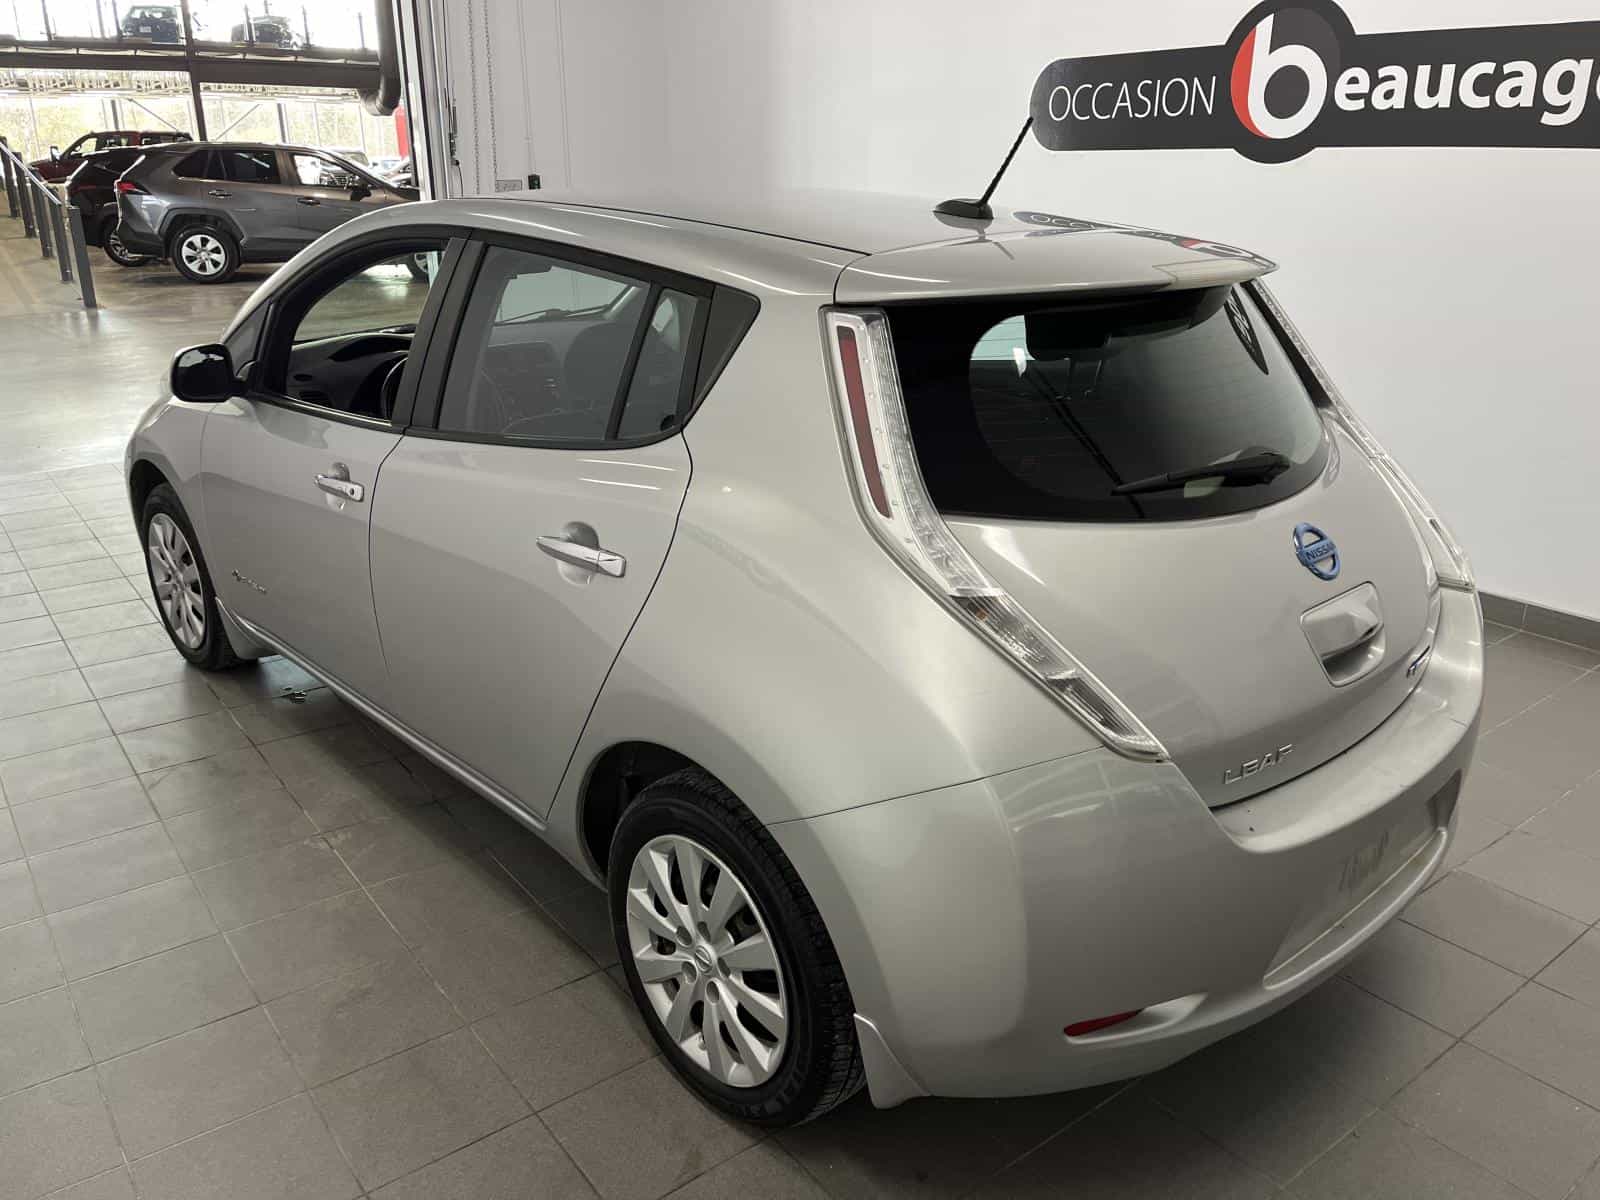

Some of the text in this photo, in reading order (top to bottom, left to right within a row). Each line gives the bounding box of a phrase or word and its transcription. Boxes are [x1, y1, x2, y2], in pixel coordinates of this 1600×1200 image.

[1048, 12, 1600, 139] OCCASION beaucag
[1223, 744, 1294, 785] LEAF
